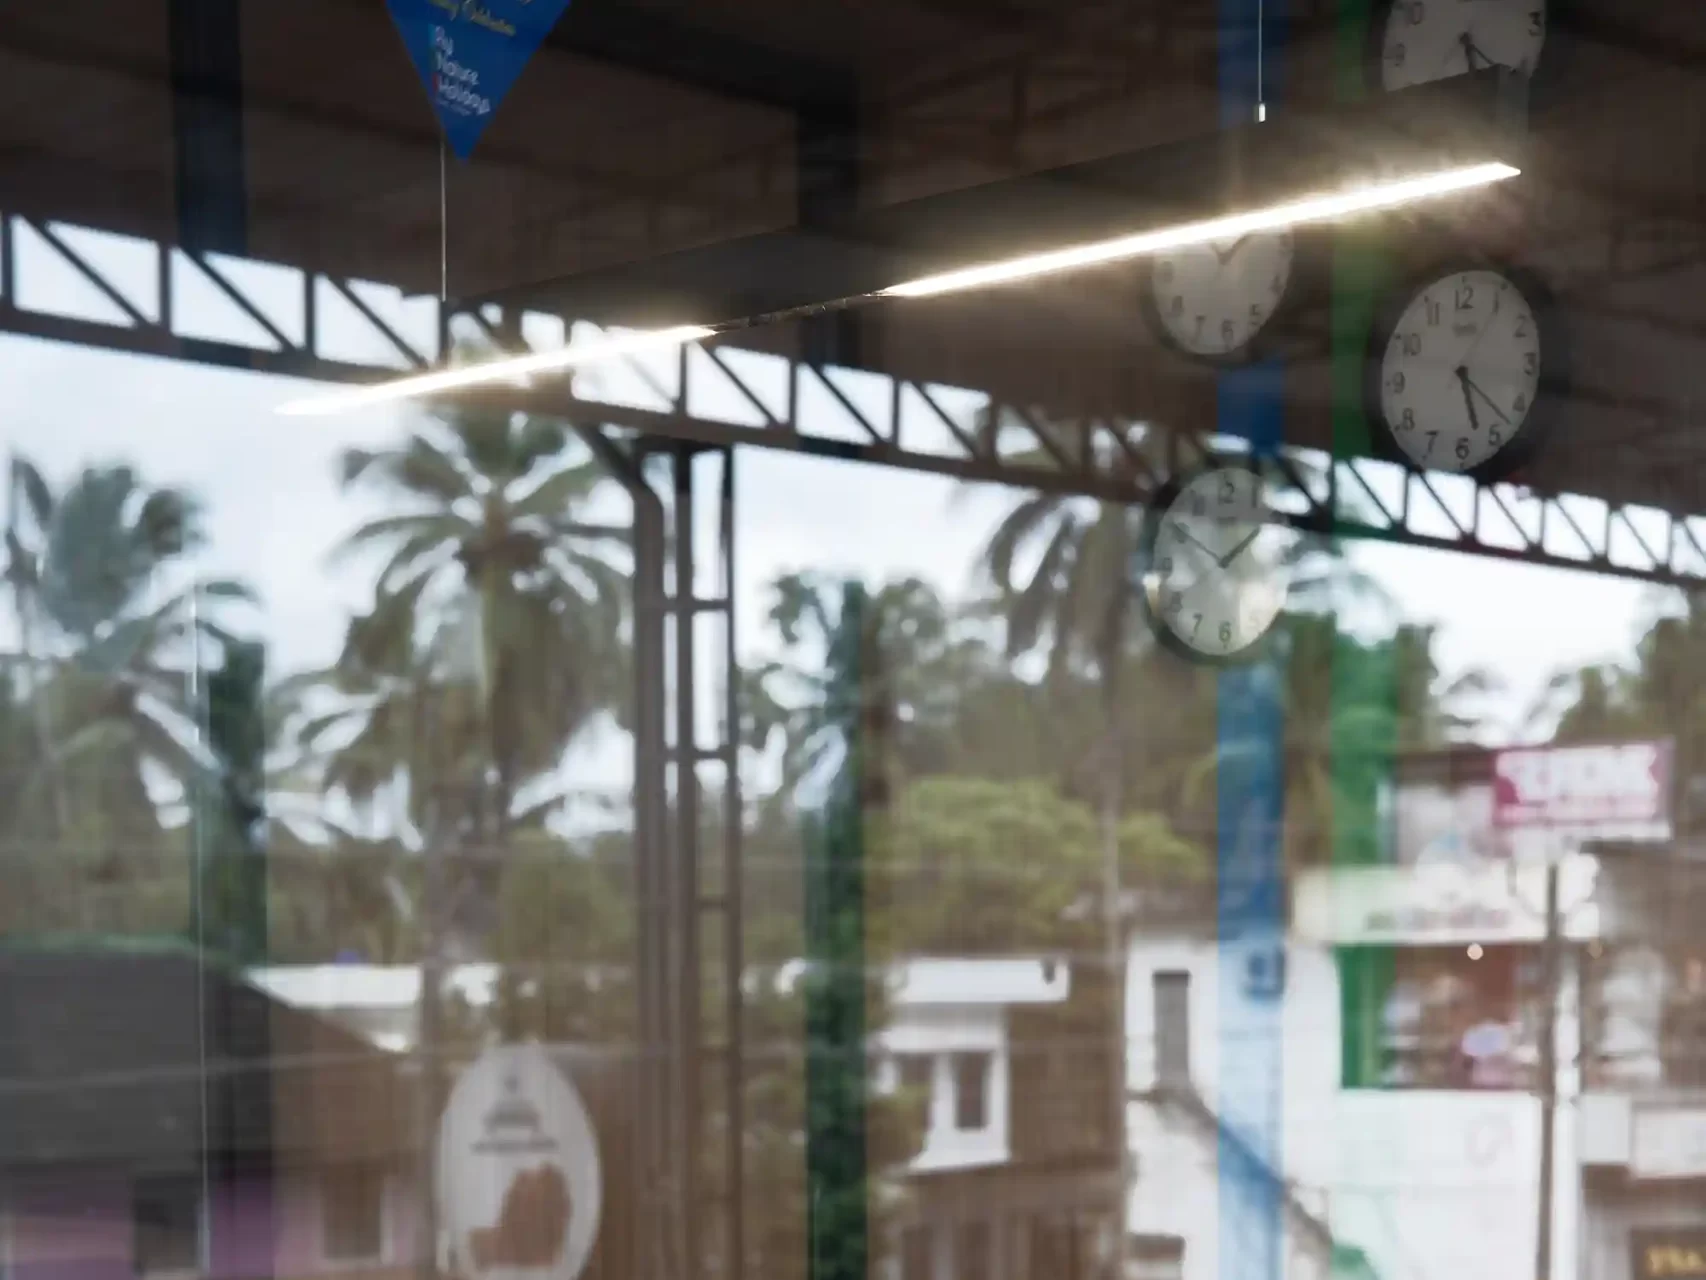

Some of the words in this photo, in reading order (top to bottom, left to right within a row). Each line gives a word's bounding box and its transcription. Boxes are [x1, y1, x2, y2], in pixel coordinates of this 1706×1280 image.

[1455, 287, 1474, 309] 12
[1426, 301, 1440, 325] 11
[1515, 314, 1527, 338] 2
[1402, 334, 1422, 356] 10
[1524, 352, 1536, 376] 3
[1393, 372, 1405, 394] 9
[1513, 393, 1525, 412] 4
[1403, 409, 1415, 431] 8
[1425, 431, 1438, 454] 7
[1488, 424, 1501, 445] 5
[1455, 437, 1469, 459] 6
